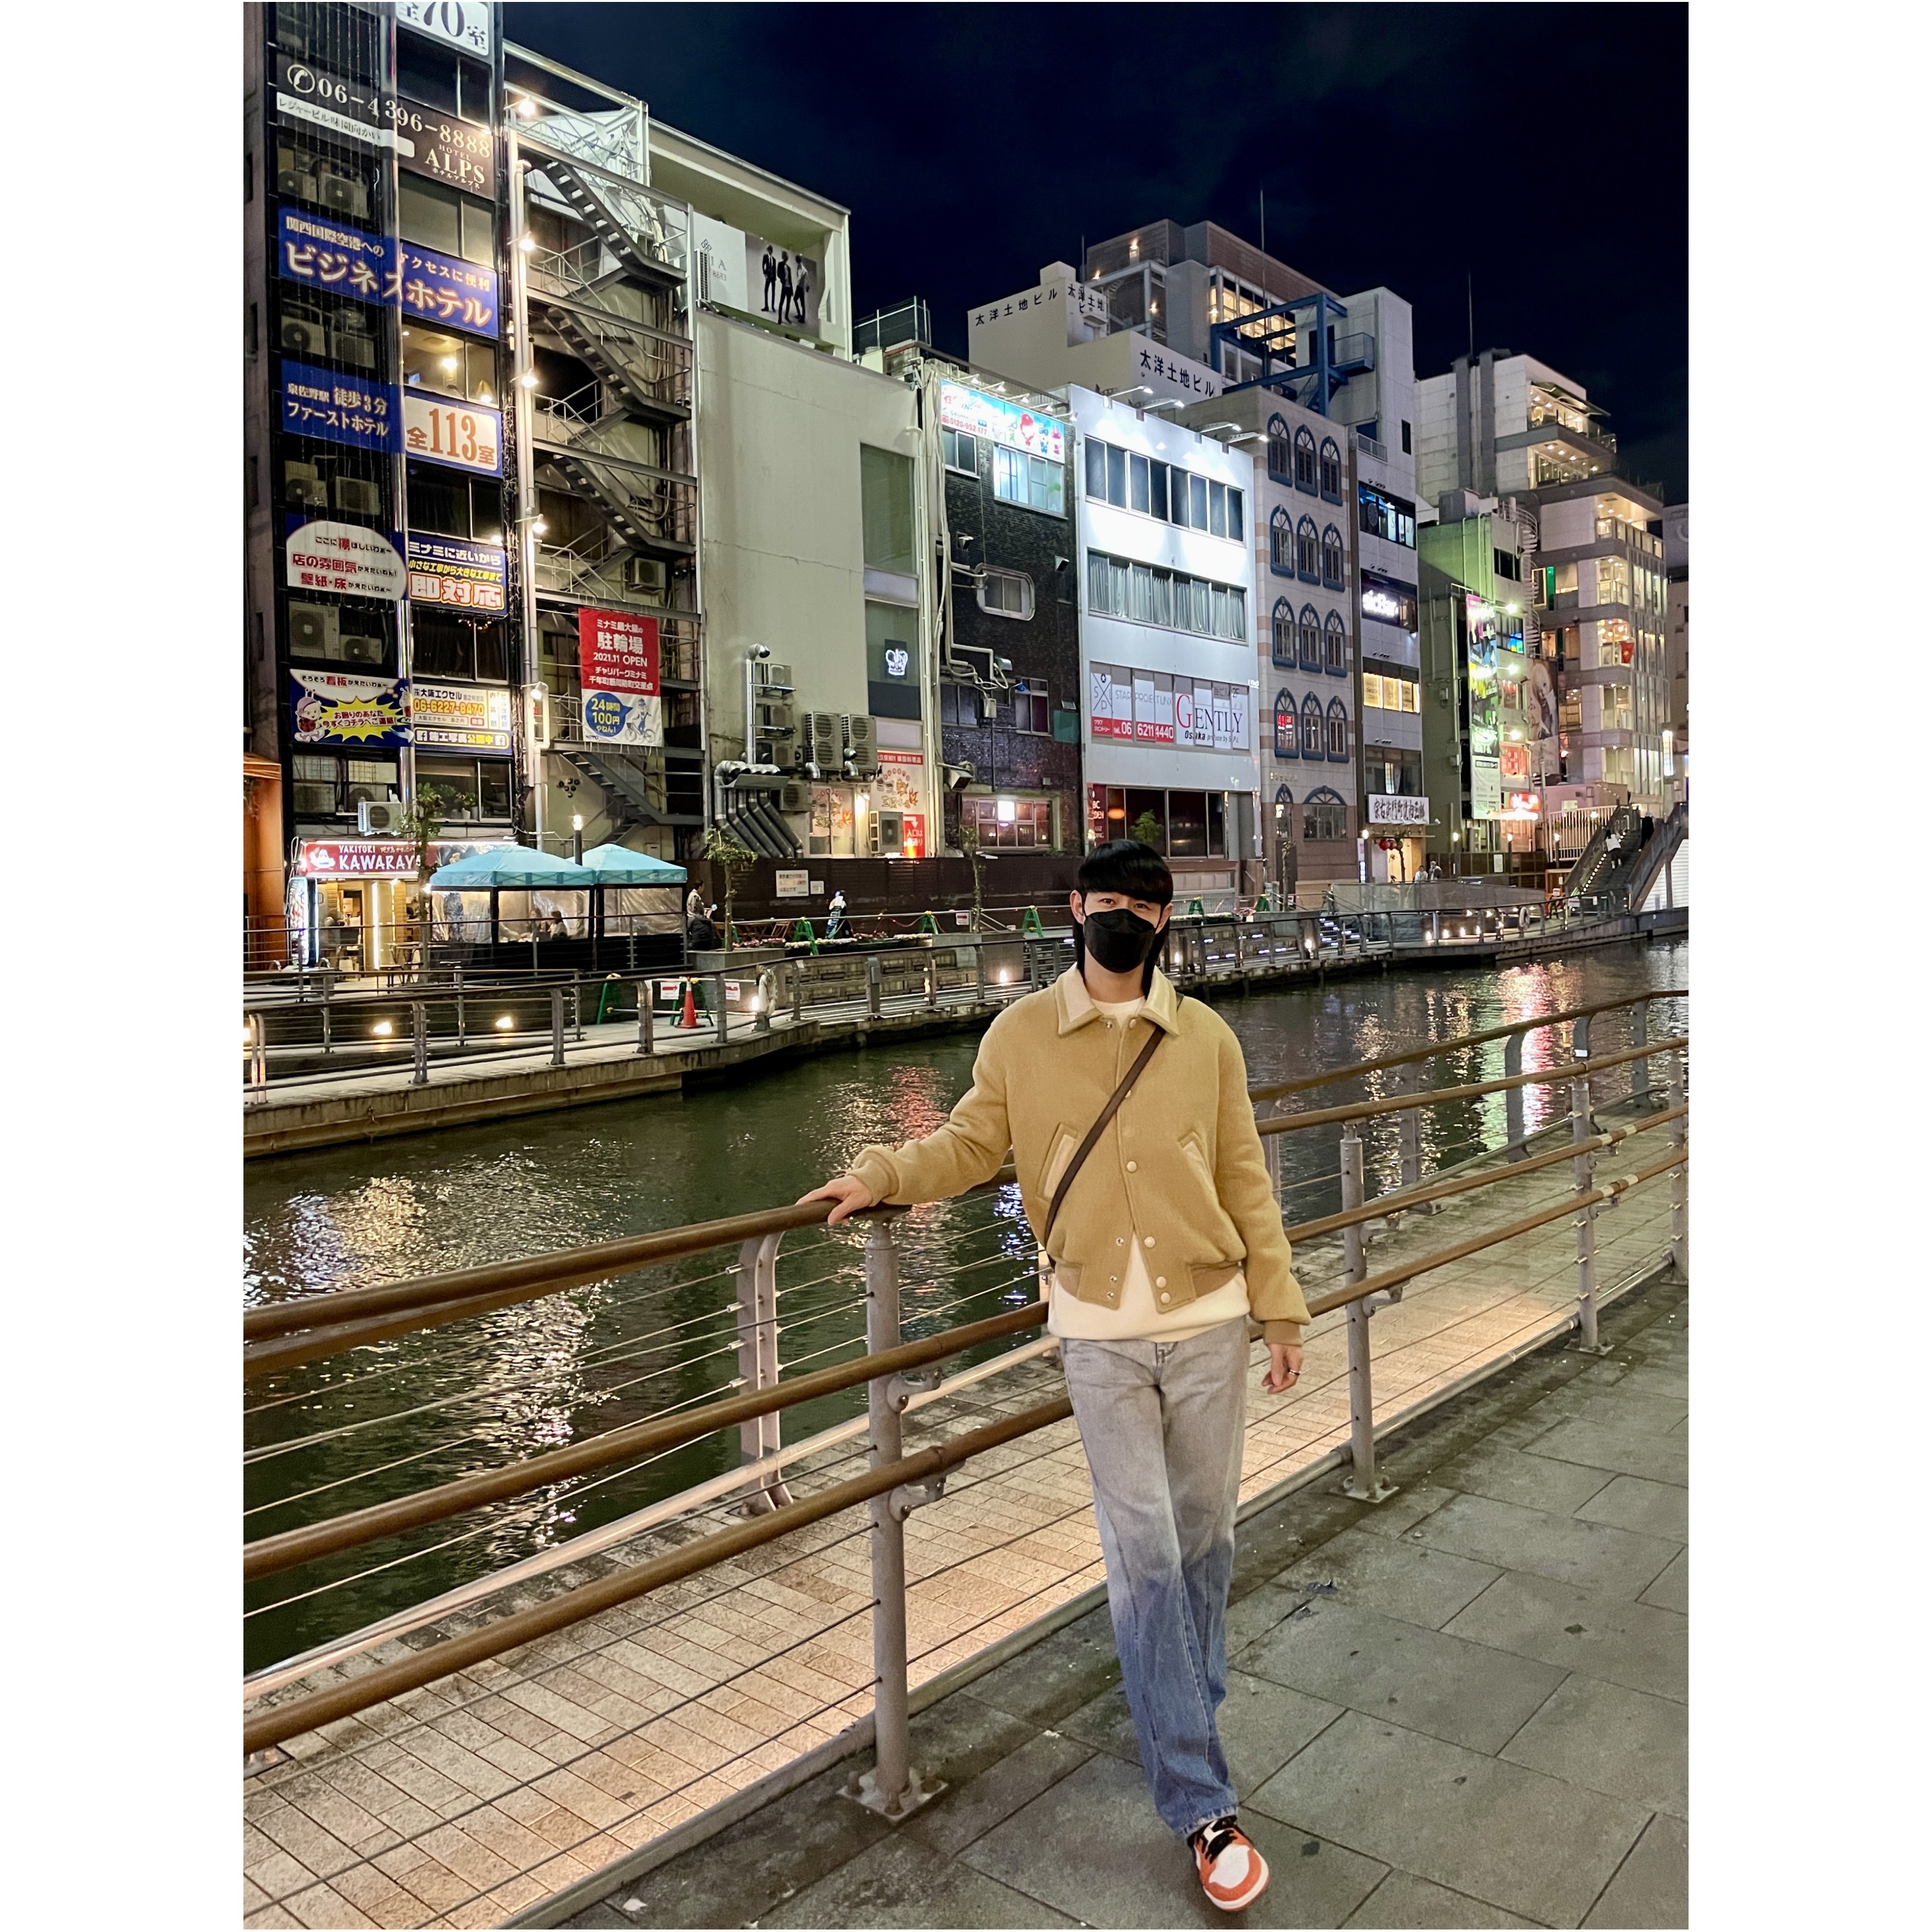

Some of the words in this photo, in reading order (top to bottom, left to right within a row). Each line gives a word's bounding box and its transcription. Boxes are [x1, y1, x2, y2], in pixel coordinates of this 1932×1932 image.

[318, 78, 491, 158] 06-4396-8888
[439, 144, 471, 161] HOTEL
[425, 148, 486, 184] ALPS
[432, 167, 480, 189] ホテルアルプス
[285, 216, 384, 258] 関西国際空港への
[285, 242, 492, 327] ビジネスホテル
[975, 287, 1058, 327] 太洋土地ビル
[1140, 349, 1216, 398] 太洋土地ビル
[333, 386, 388, 416] 徒歩3分
[287, 401, 389, 437] ファーストホテル
[406, 408, 497, 466] 全113室
[408, 541, 501, 566] ミナミに近いから
[411, 573, 503, 608] 即対応
[596, 619, 643, 634] ミナミ最大級の
[597, 631, 643, 655] 駐輪場
[593, 652, 620, 663] 2021.11
[623, 655, 648, 667] OPEN
[595, 666, 647, 680] チャリパークミナミ
[413, 699, 484, 716] 06-6227-8470
[591, 697, 621, 712] 24時間
[1176, 694, 1243, 733] GENTLY
[592, 712, 620, 725] 100円
[1121, 721, 1132, 735] 06
[1137, 723, 1154, 737] 6211
[339, 845, 375, 853] YAKITORI
